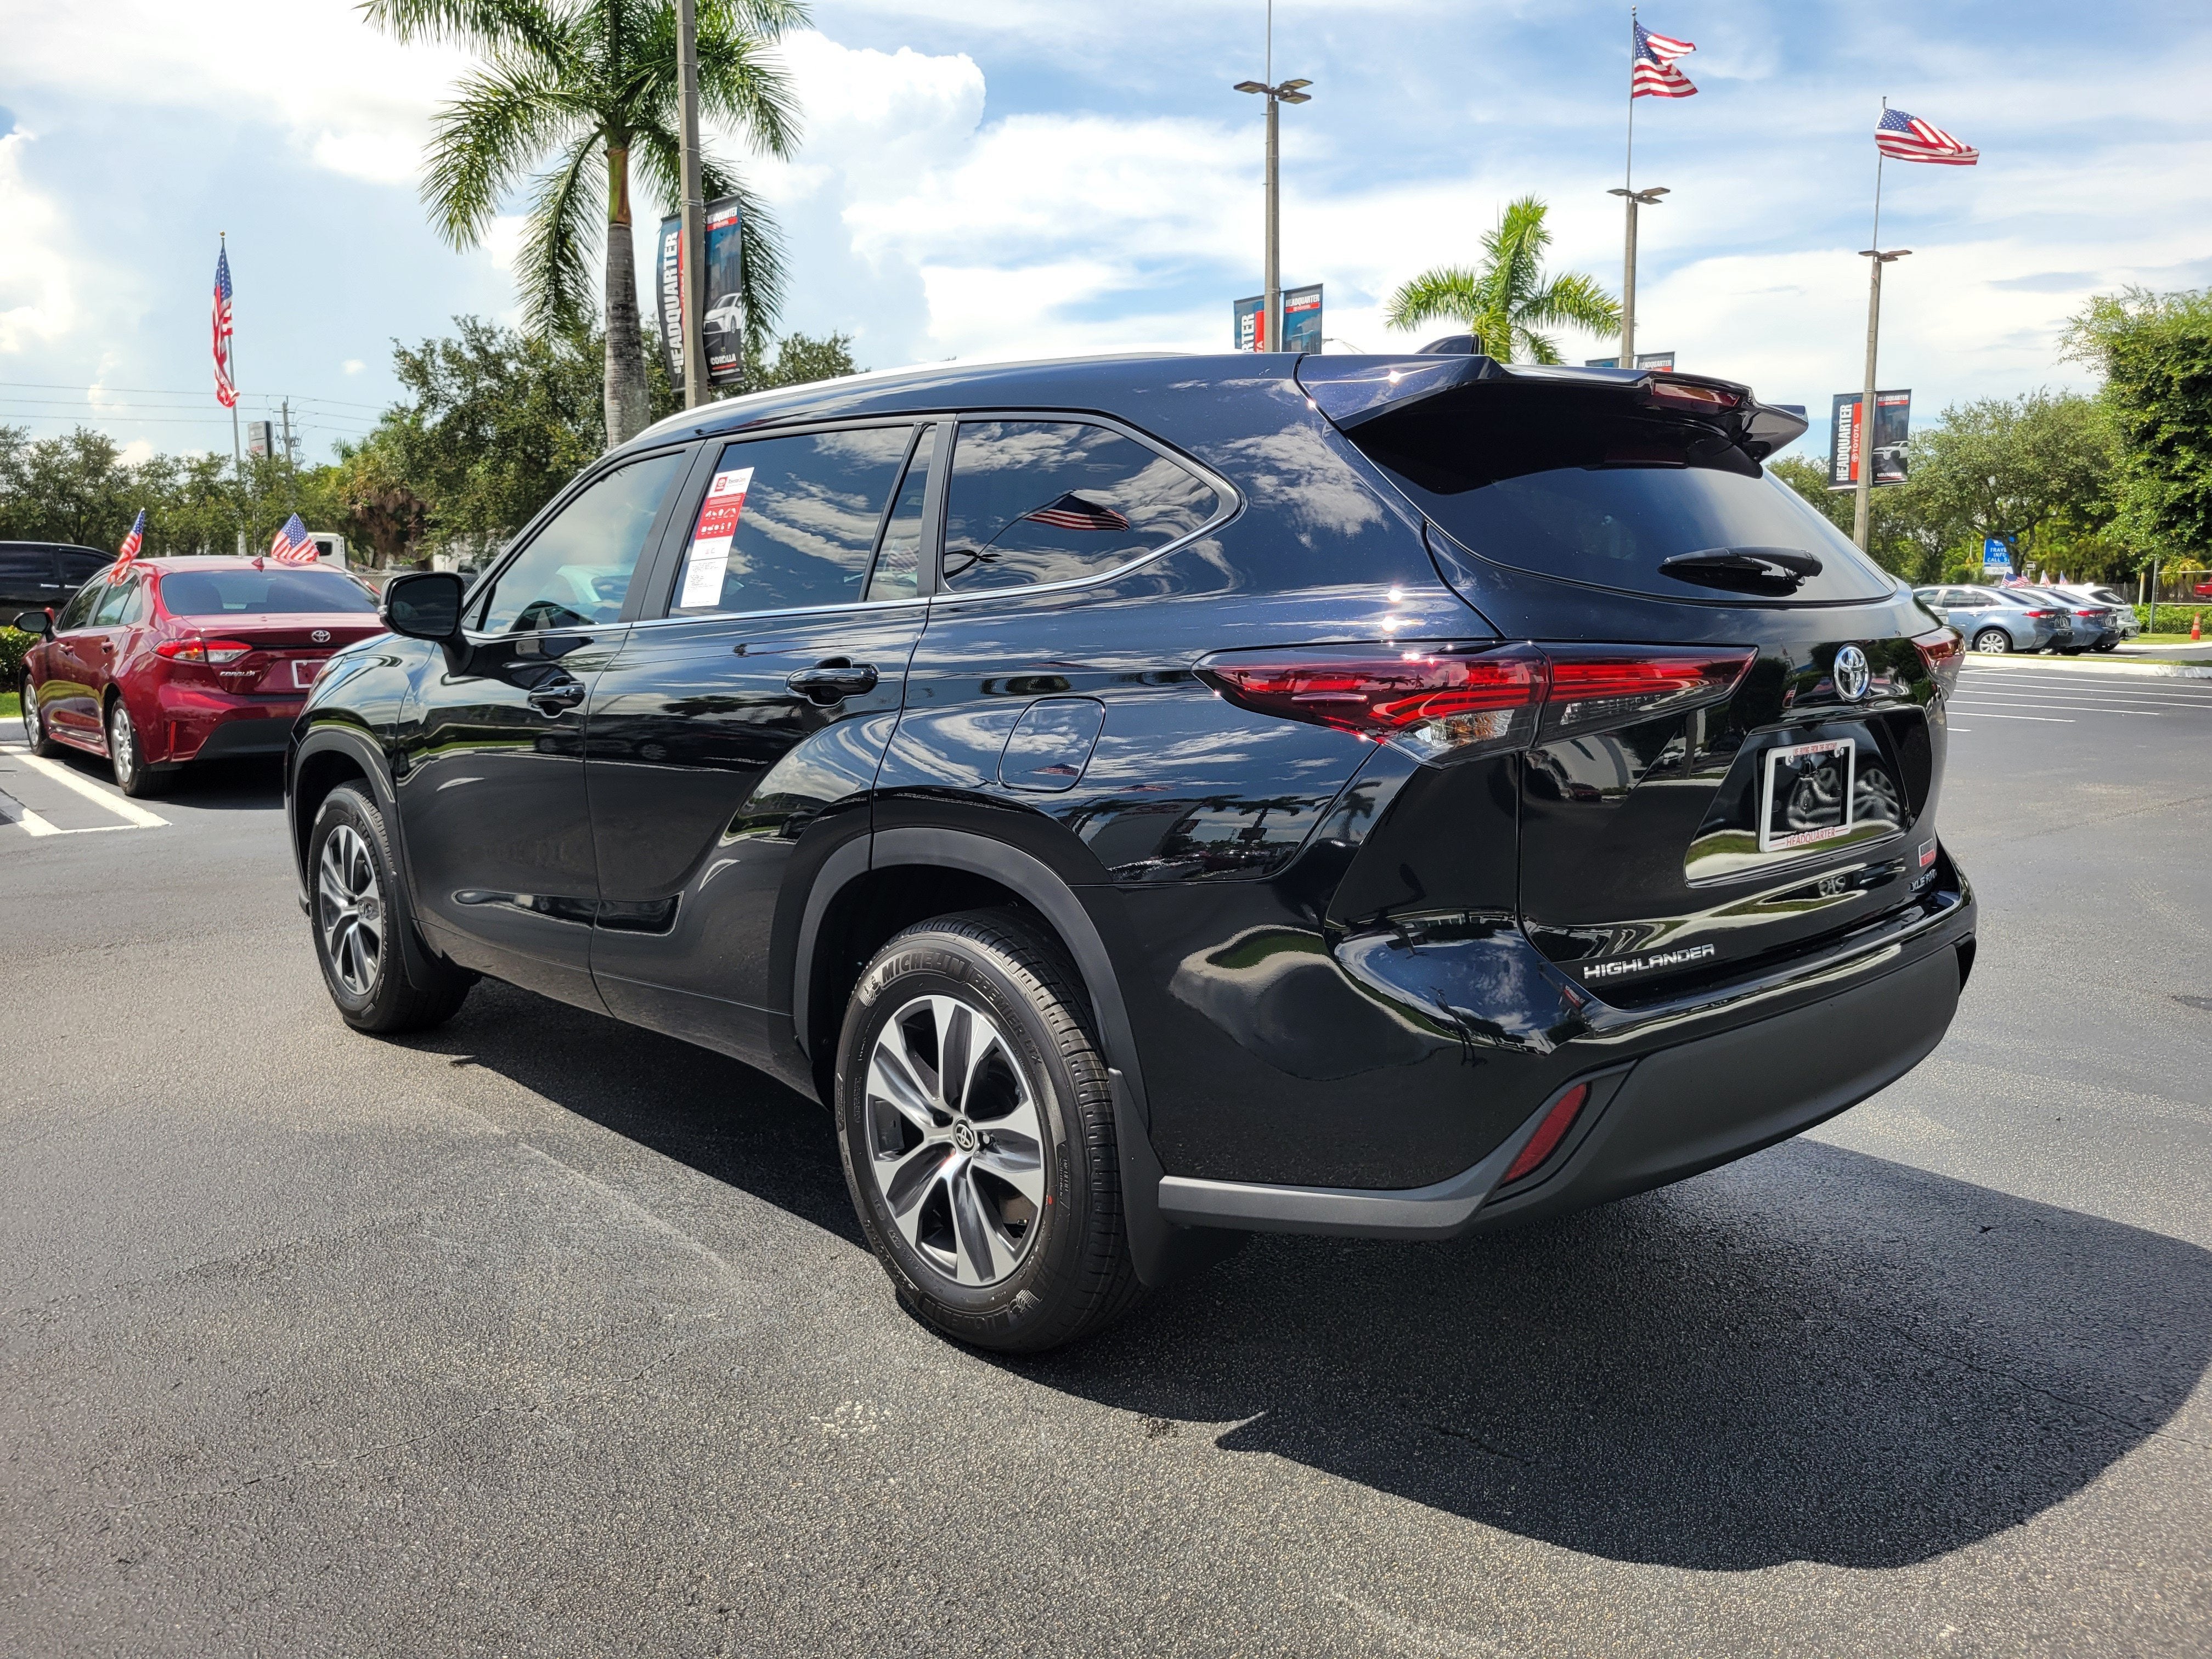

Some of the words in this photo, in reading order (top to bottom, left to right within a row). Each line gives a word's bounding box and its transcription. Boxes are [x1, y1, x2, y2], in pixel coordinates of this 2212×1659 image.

[663, 231, 684, 374] HEADQUARTER
[1836, 403, 1853, 481] HEADQUARTER
[1786, 827, 1835, 847] HEADQUARTER
[882, 951, 966, 981] MICHELIN
[1583, 943, 1715, 979] HIGHLANDER
